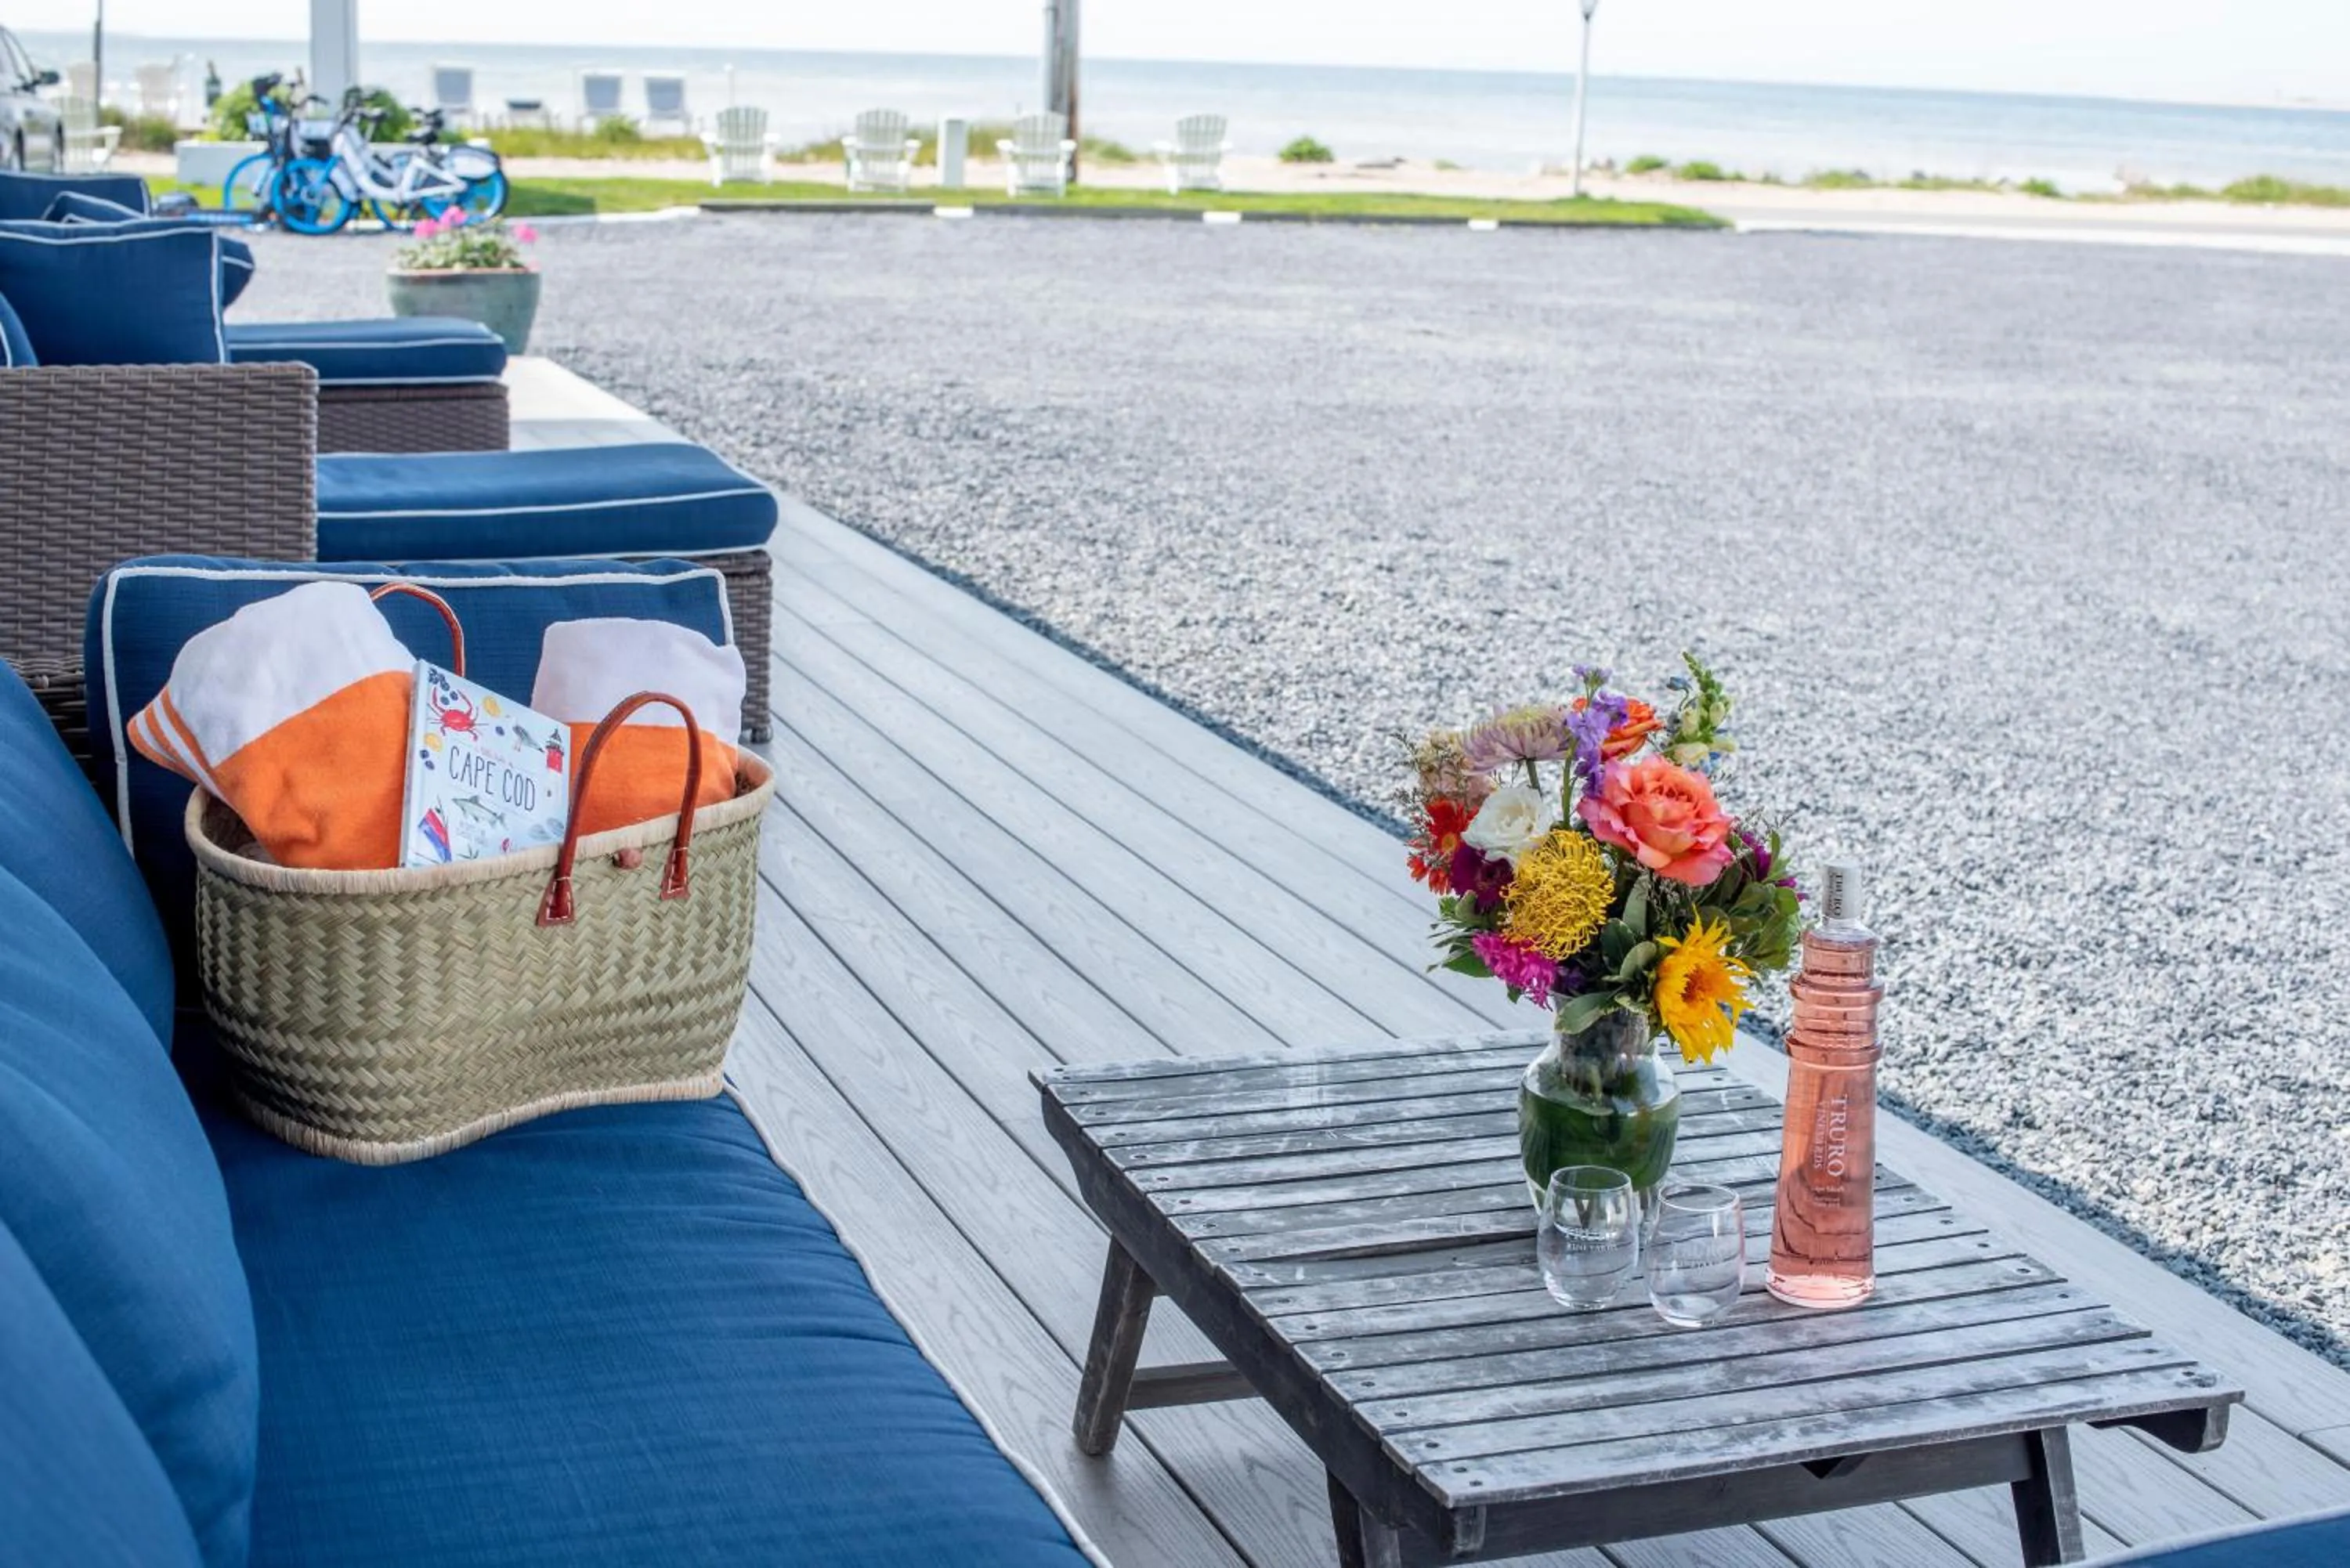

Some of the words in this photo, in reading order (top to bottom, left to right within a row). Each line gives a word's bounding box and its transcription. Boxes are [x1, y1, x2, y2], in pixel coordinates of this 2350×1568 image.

[449, 746, 496, 795] CAPE
[503, 769, 536, 811] COD
[1827, 1093, 1848, 1176] TRURO
